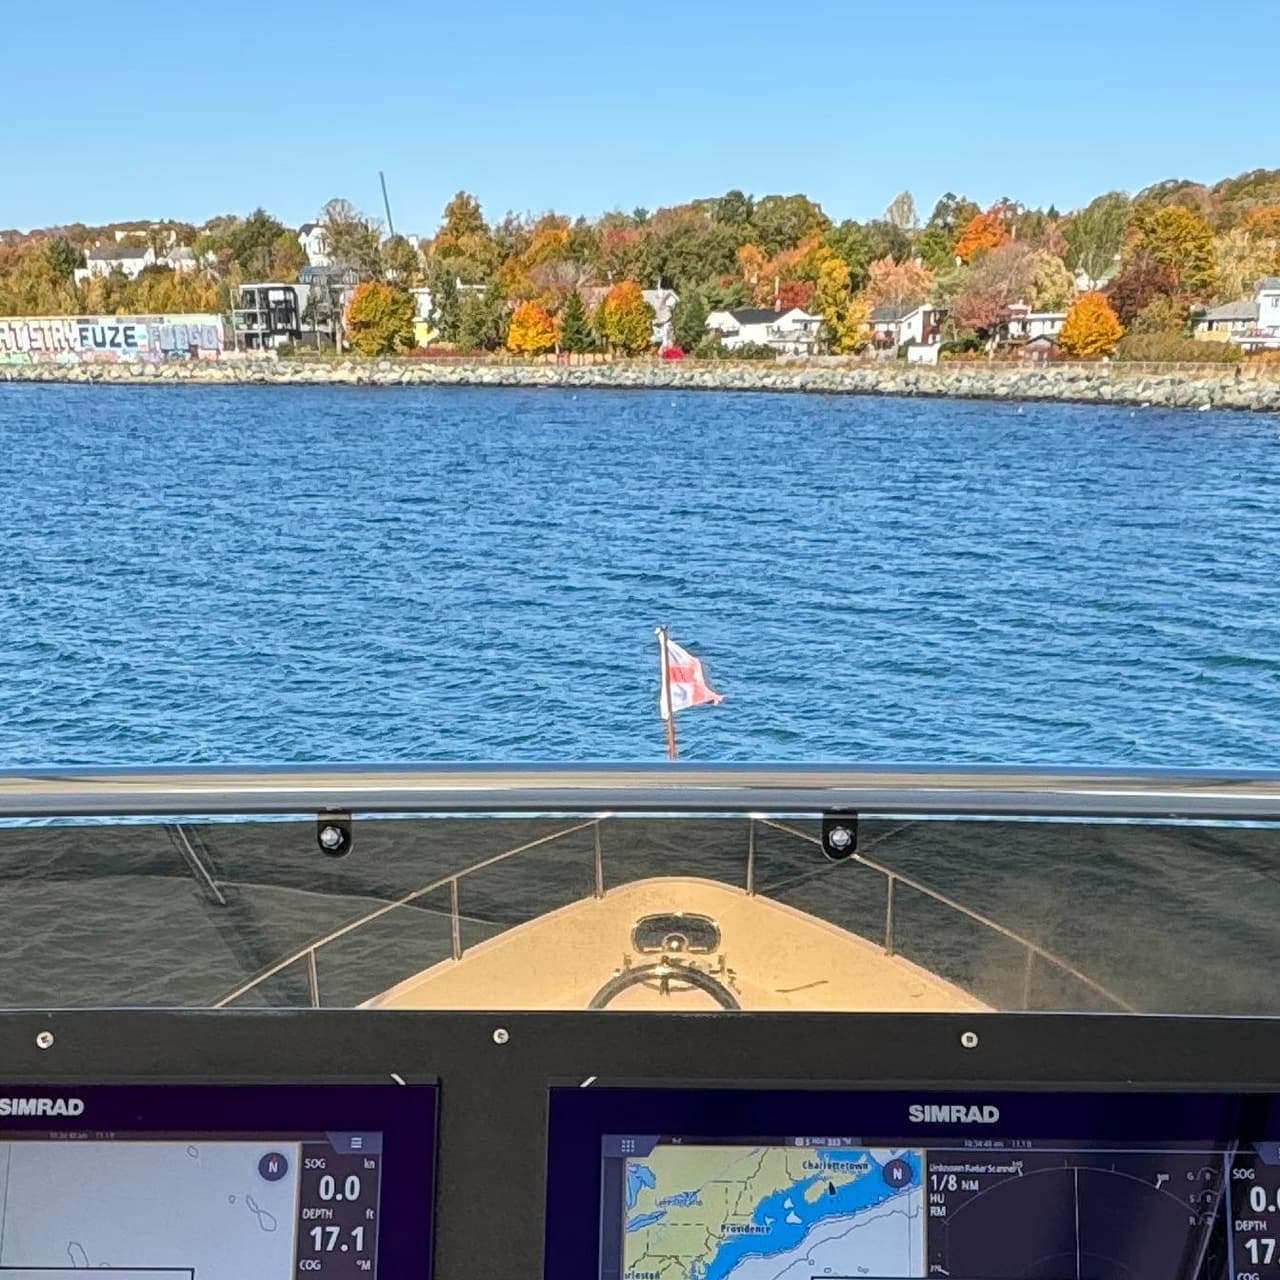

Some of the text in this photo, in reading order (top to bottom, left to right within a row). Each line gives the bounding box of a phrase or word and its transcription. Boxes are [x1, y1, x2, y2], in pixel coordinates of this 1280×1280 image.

[78, 325, 138, 348] FUZE
[908, 1105, 1000, 1123] SIMRAD
[268, 1161, 278, 1173] N
[304, 1158, 376, 1169] SOG kn
[893, 1168, 902, 1179] N
[1232, 1168, 1256, 1180] SOG
[319, 1175, 361, 1201] 0.0
[930, 1174, 958, 1191] 1/8
[302, 1208, 374, 1219] DEPTH ft
[720, 1224, 771, 1234] Providence
[1235, 1220, 1268, 1231] DEPTH
[310, 1226, 364, 1251] 17.1
[299, 1259, 321, 1270] COG
